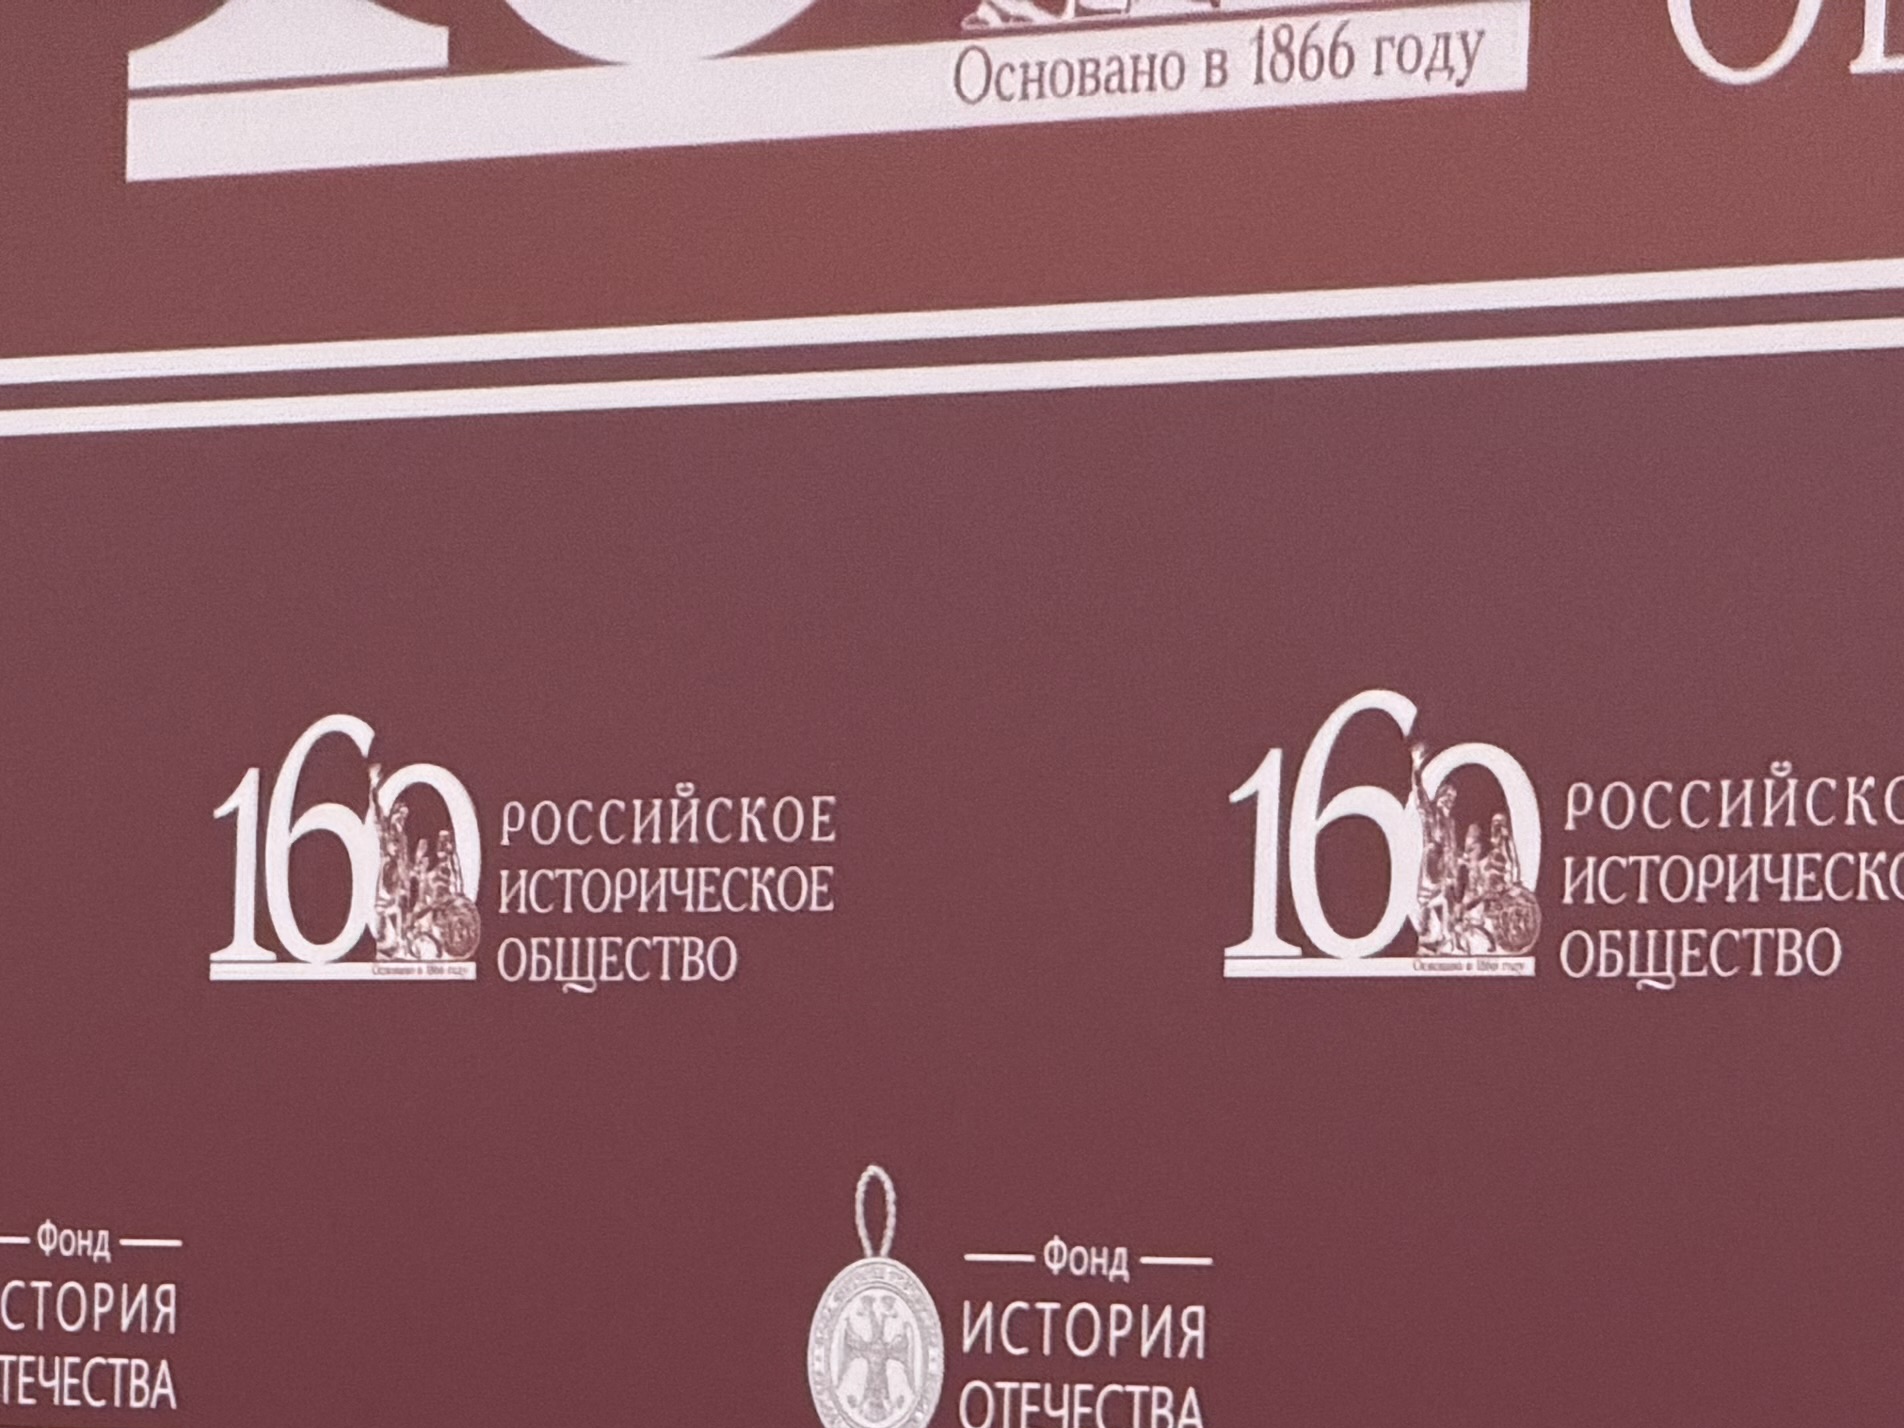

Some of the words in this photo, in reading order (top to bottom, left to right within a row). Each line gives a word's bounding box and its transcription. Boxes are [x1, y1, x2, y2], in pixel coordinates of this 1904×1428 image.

[953, 44, 1186, 103] Основано
[1203, 46, 1228, 88] в
[1249, 21, 1357, 86] 1866
[1372, 28, 1486, 88] году
[500, 781, 838, 846] РОССИЙСКОЕ
[1564, 760, 1904, 832] РОССИЙСКО
[498, 865, 836, 913] ИСТОРИЧЕСКОЕ
[496, 935, 739, 994] ОБЩЕСТВО
[1560, 926, 1842, 991] ОБЩЕСТВО
[37, 1218, 112, 1264] Фонд
[1043, 1234, 1130, 1284] Фонд
[961, 1300, 1206, 1360] ИСТОРИЯ
